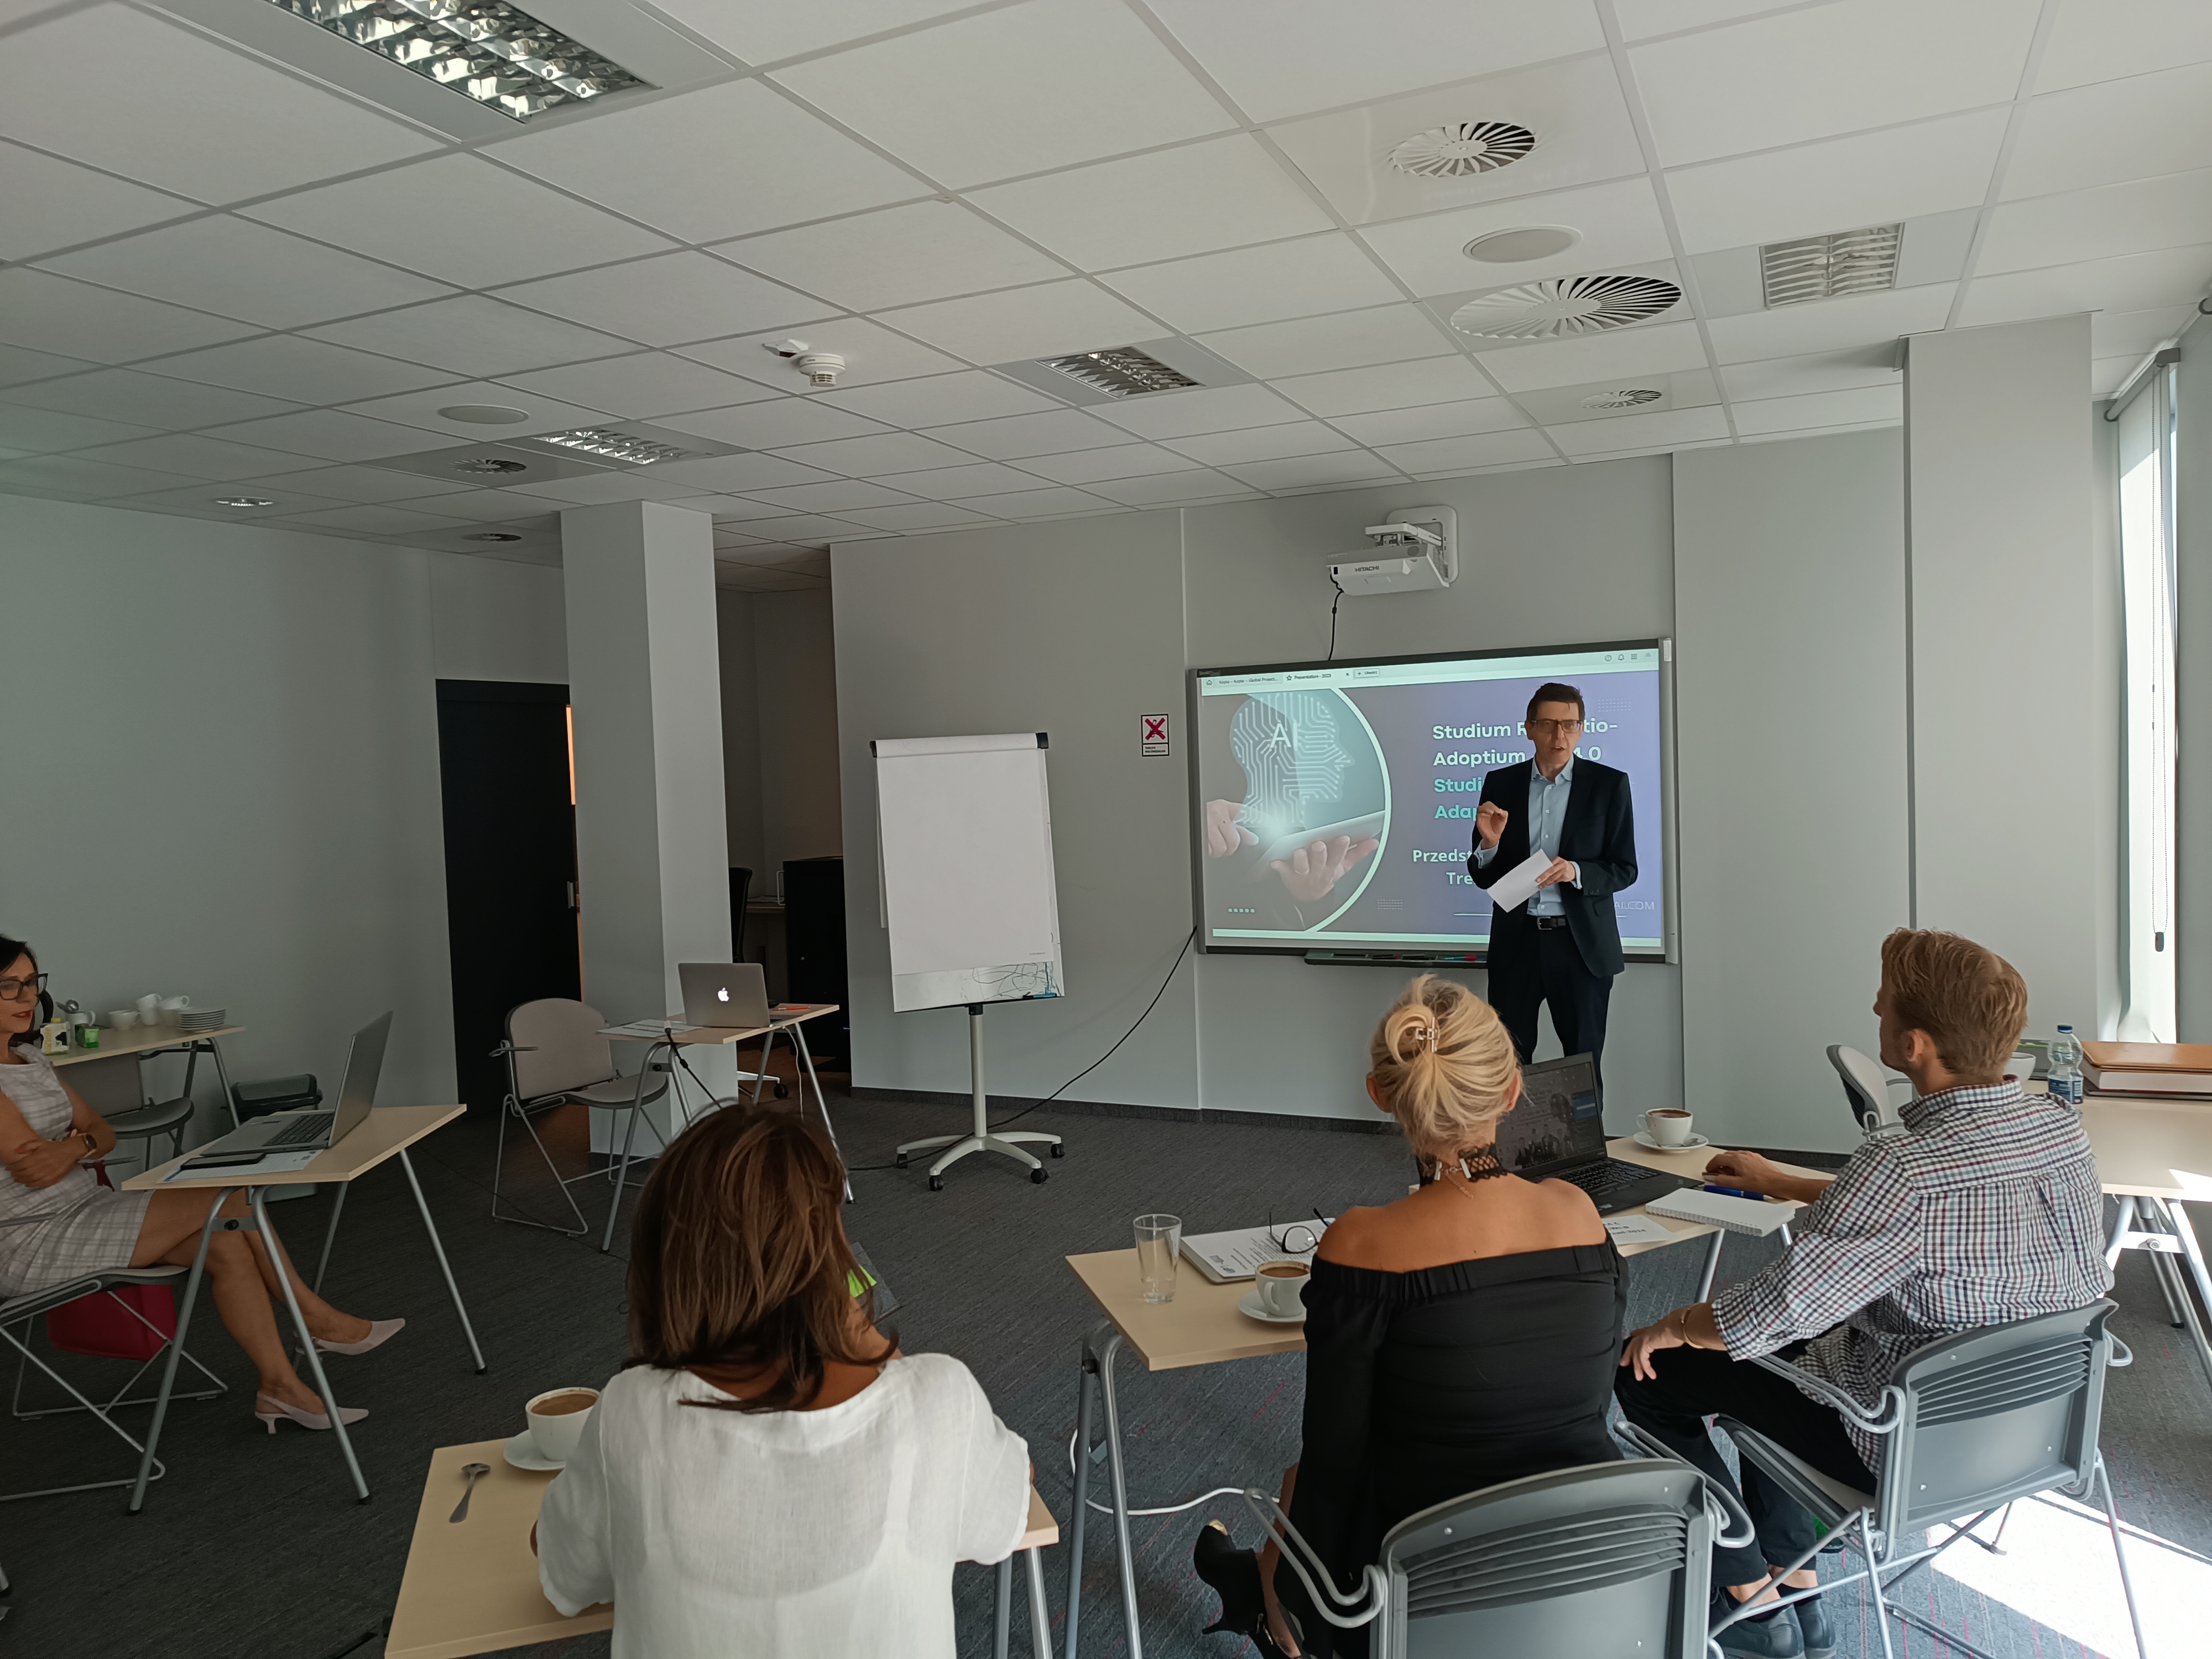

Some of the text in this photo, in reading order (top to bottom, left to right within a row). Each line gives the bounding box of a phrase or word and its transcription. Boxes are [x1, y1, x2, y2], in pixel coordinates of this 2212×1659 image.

[1270, 722, 1298, 749] AI
[1432, 722, 1511, 740] Studium
[1432, 749, 1526, 768] Adoptium
[1434, 776, 1483, 793] Studi
[1446, 872, 1473, 885] Tre
